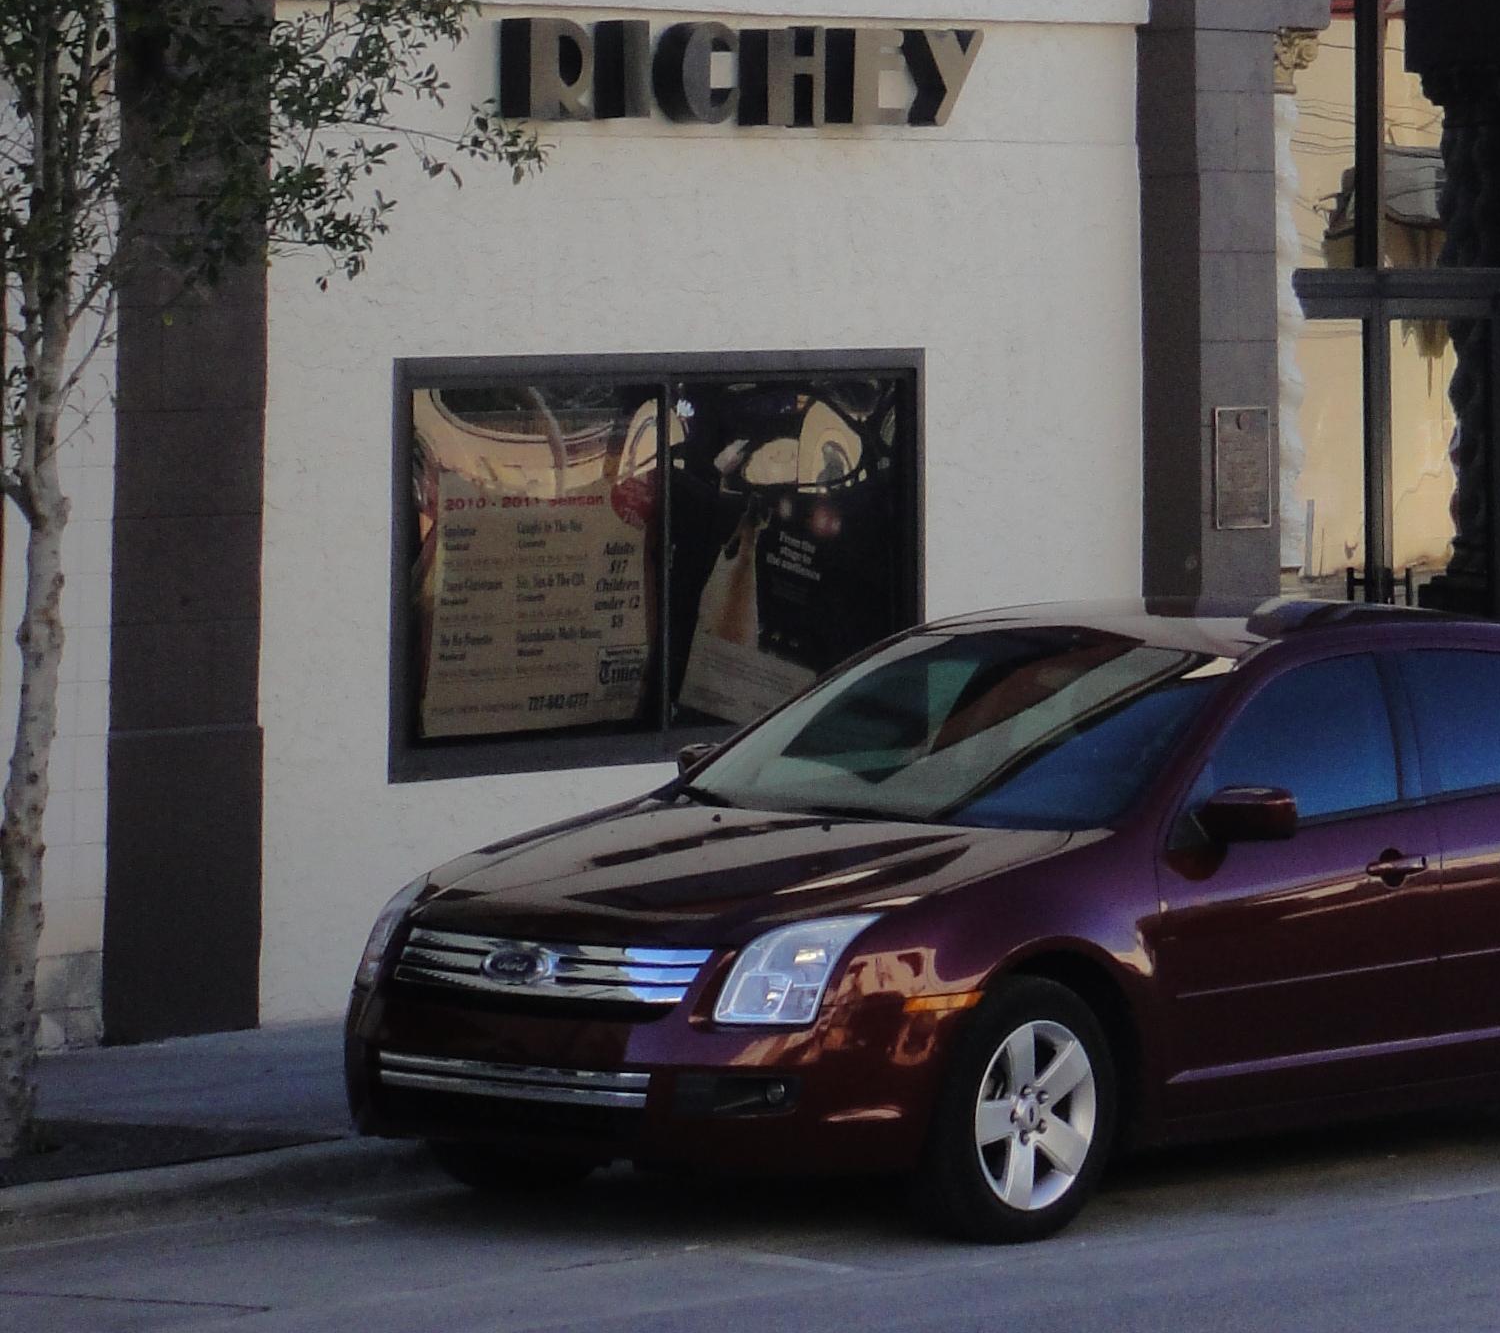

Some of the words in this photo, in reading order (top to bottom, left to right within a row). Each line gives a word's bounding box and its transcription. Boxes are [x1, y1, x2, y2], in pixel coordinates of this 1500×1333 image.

[497, 16, 985, 128] RICHEY
[444, 497, 487, 511] 2010
[501, 496, 540, 509] 2011
